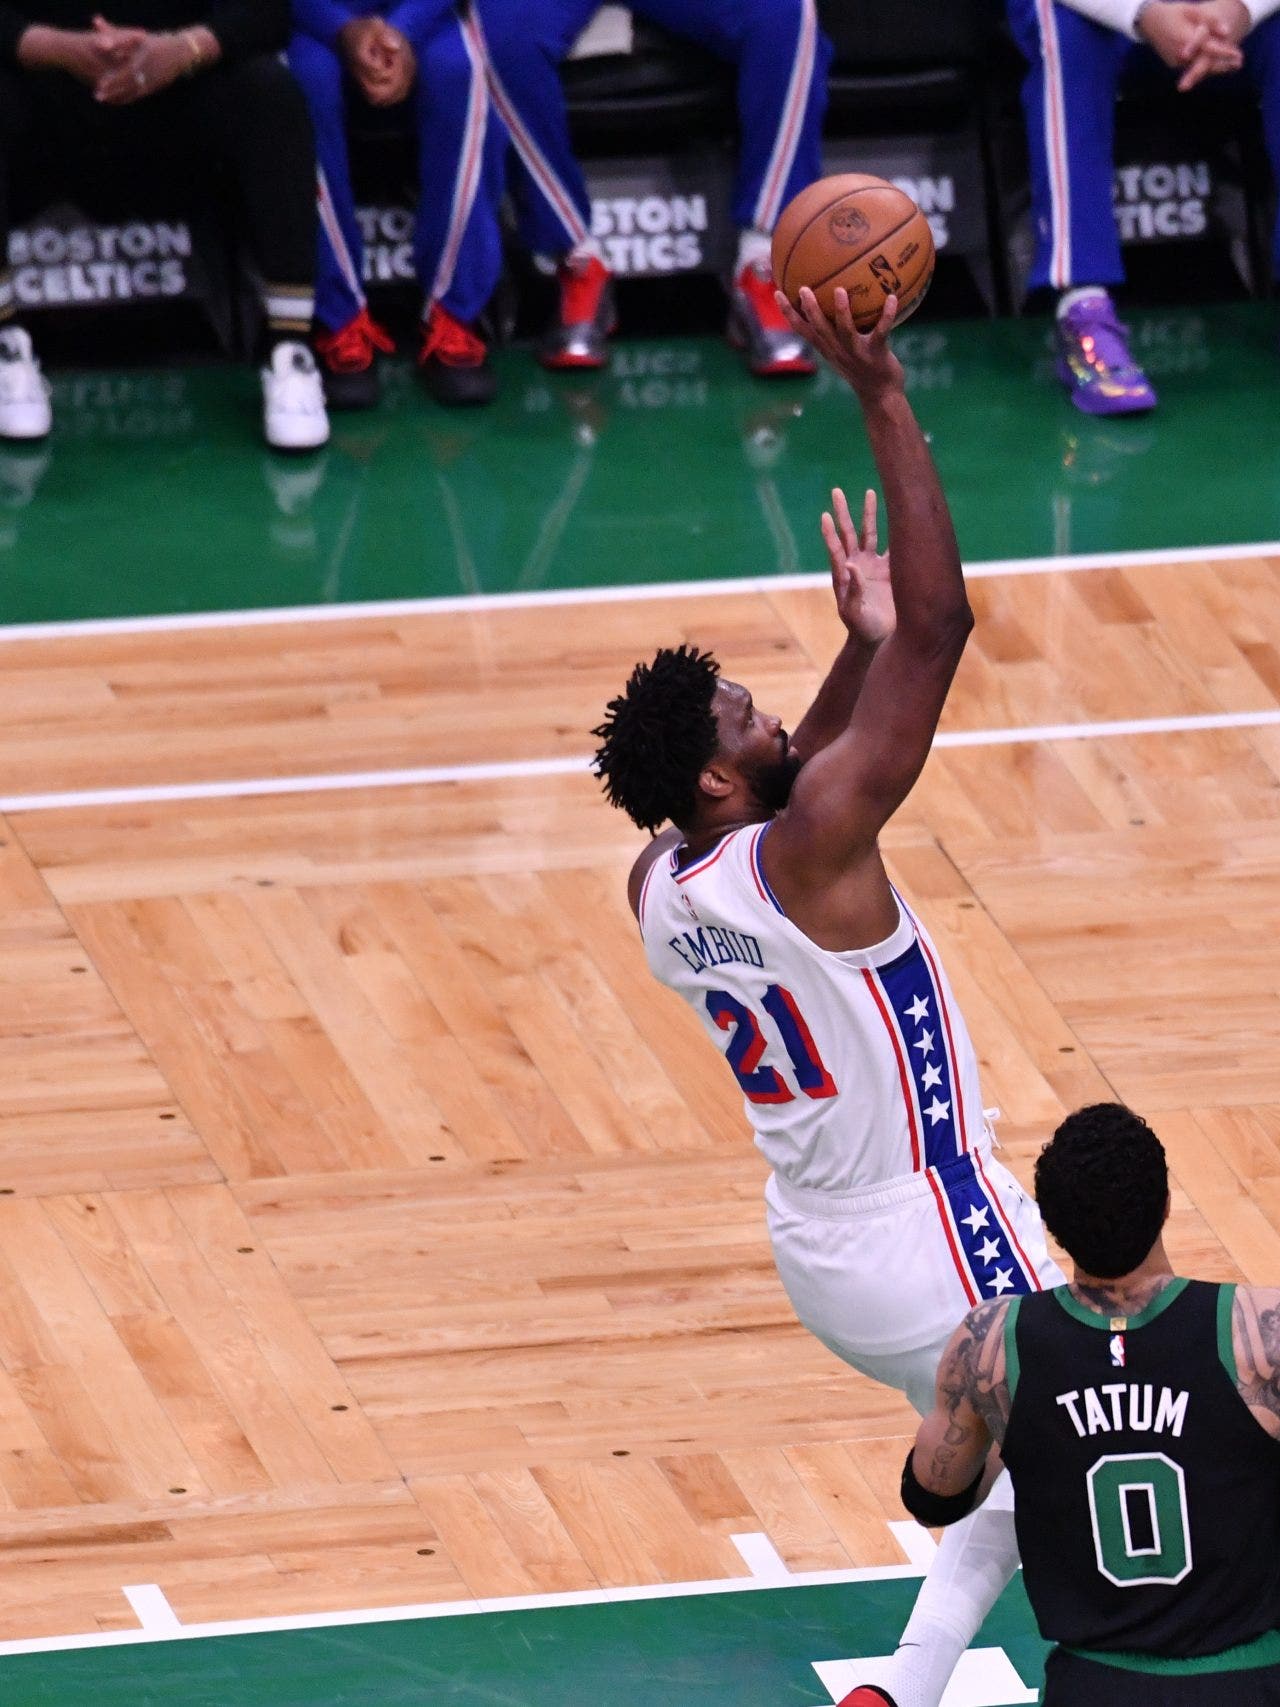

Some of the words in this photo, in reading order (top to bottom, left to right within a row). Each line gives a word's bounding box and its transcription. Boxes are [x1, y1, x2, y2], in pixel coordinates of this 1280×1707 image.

[591, 194, 708, 236] STON
[6, 222, 192, 265] BOSTON
[14, 258, 187, 302] CELTICS
[668, 926, 765, 974] EMBIID
[704, 983, 839, 1105] 21
[1056, 1383, 1190, 1438] TATUM
[1086, 1452, 1193, 1587] 0
